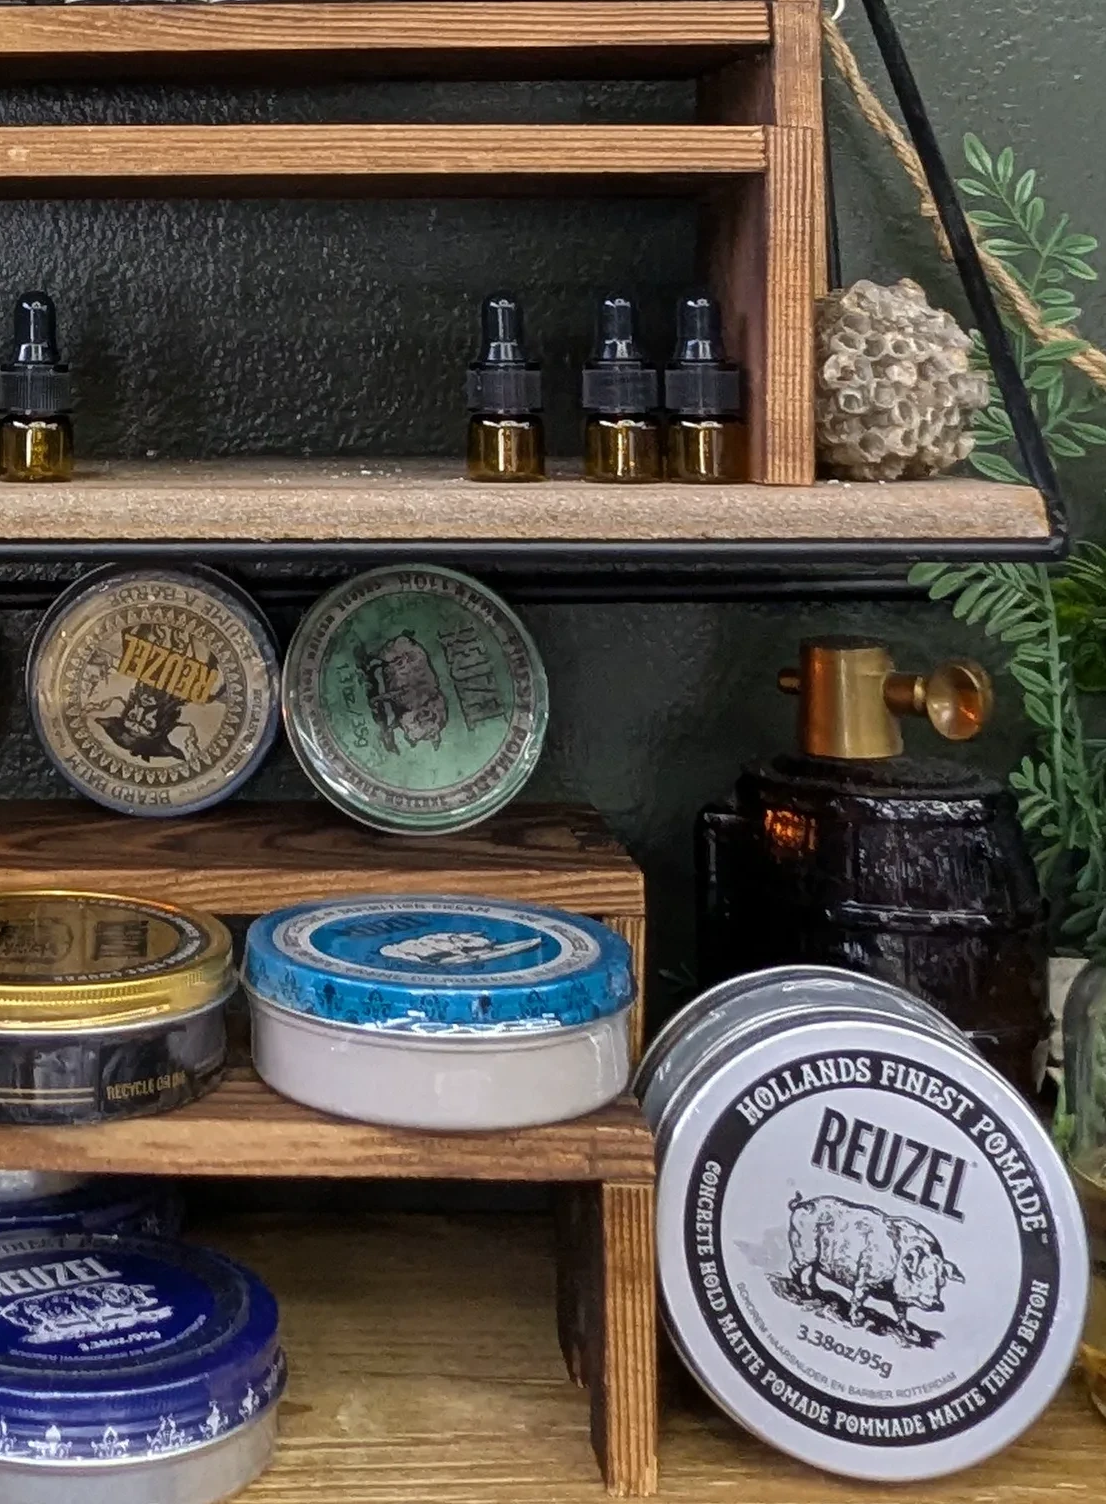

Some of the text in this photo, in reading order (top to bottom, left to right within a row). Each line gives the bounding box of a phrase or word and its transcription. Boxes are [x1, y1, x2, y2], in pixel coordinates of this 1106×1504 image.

[117, 634, 219, 706] REUZEL
[438, 626, 511, 732] REUZEL
[65, 752, 171, 805] BEARD BALM
[106, 1078, 154, 1100] RECYCLE
[735, 1057, 1048, 1233] HOLLANDS FINEST POMADE
[811, 1107, 966, 1224] REUZEL
[695, 1160, 722, 1256] CONCRETE
[699, 1261, 727, 1312] HOLD
[717, 1312, 765, 1376] MATTE
[797, 1324, 893, 1379] 3.38oz/95g
[980, 1340, 1028, 1395] TENUE
[760, 1369, 831, 1425] POMADE
[830, 1380, 844, 1390] EN
[895, 1371, 958, 1398] ROTTERDAM
[925, 1387, 987, 1430] MATTE
[833, 1411, 926, 1437] POMMADE
